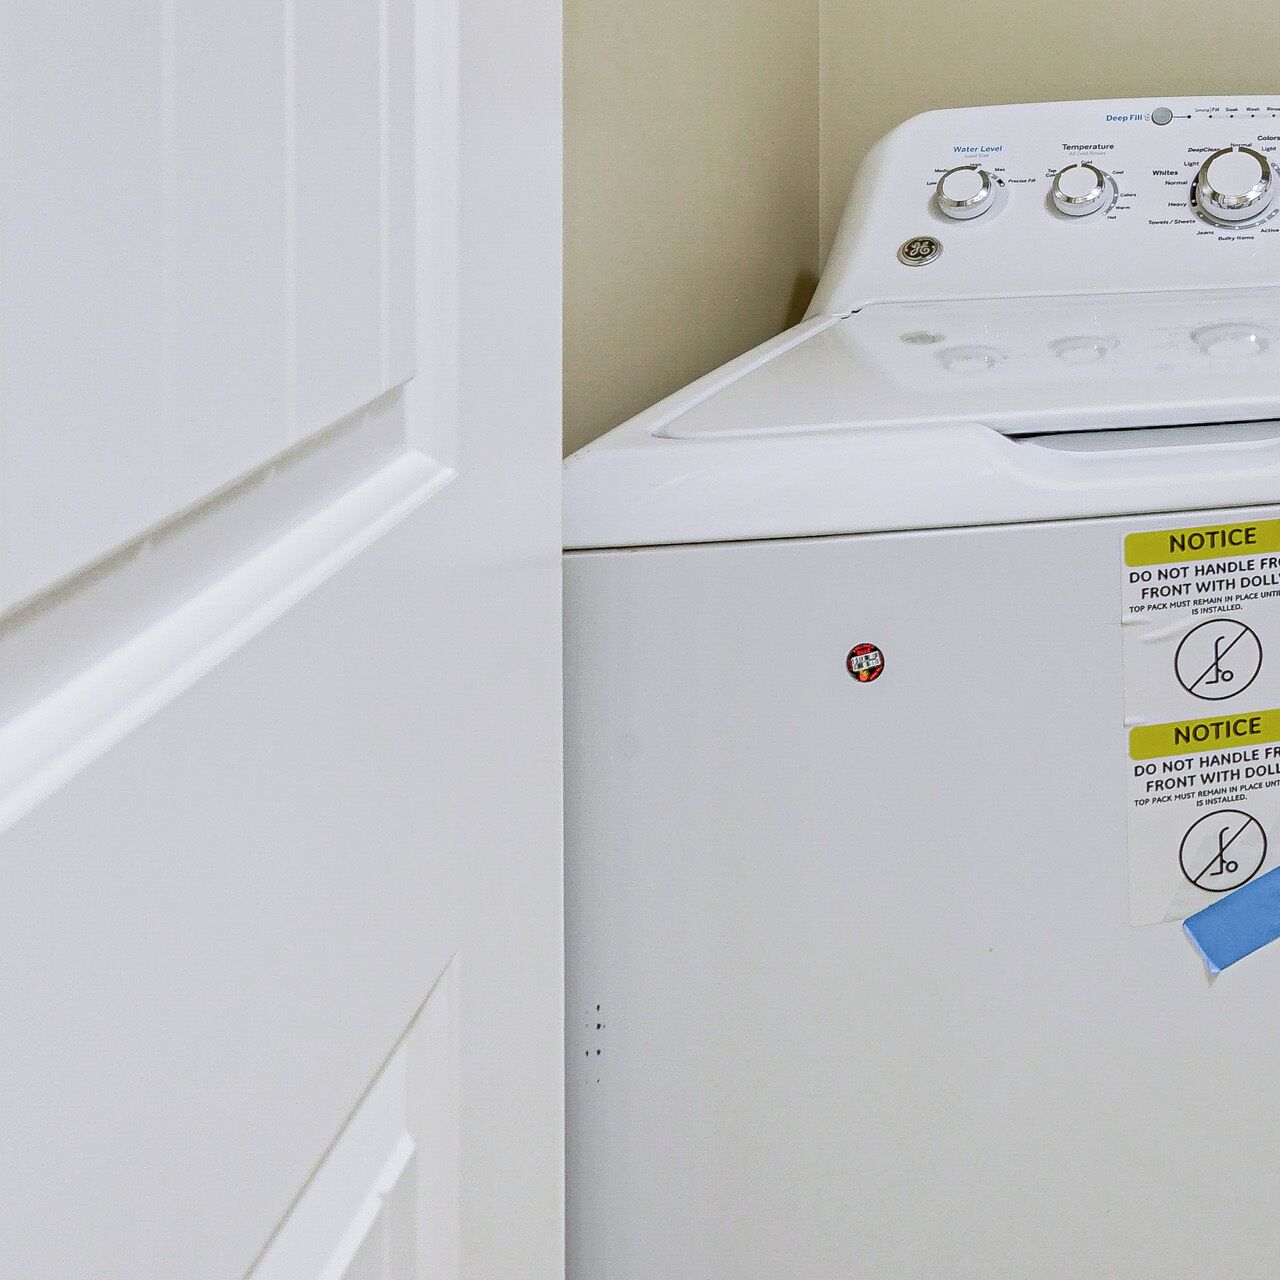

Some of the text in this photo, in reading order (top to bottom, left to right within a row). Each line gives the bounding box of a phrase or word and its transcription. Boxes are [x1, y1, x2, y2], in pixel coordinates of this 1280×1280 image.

[1105, 113, 1143, 123] Deep Fill
[953, 145, 1003, 154] Water Level
[1061, 143, 1115, 152] Temperature
[1169, 527, 1257, 553] NOTICE
[1129, 571, 1152, 584] DO
[1157, 567, 1189, 581] NOT
[1194, 560, 1255, 577] HANDLE
[1141, 584, 1192, 600] FRONT
[1196, 578, 1236, 593] WITH
[1129, 605, 1145, 614] TOP
[1147, 602, 1168, 611] PACK
[1169, 600, 1190, 609] MUST
[1193, 596, 1223, 606] REMAIN
[1224, 595, 1233, 603] IN
[1235, 592, 1258, 602] PLACE
[1200, 603, 1243, 614] INSTALLED.
[1174, 717, 1261, 746] NOTICE
[1134, 764, 1157, 777] DO
[1162, 758, 1194, 773] NOT
[1199, 749, 1260, 768] HANDLE
[1146, 775, 1197, 793] FRONT
[1200, 769, 1241, 784] WITH
[1134, 798, 1150, 806] TOP
[1152, 795, 1172, 804] PACK
[1174, 791, 1195, 801] MUST
[1197, 787, 1227, 798] REMAIN
[1240, 782, 1263, 791] PLACE
[1196, 793, 1248, 807] IS INSTALLED.
